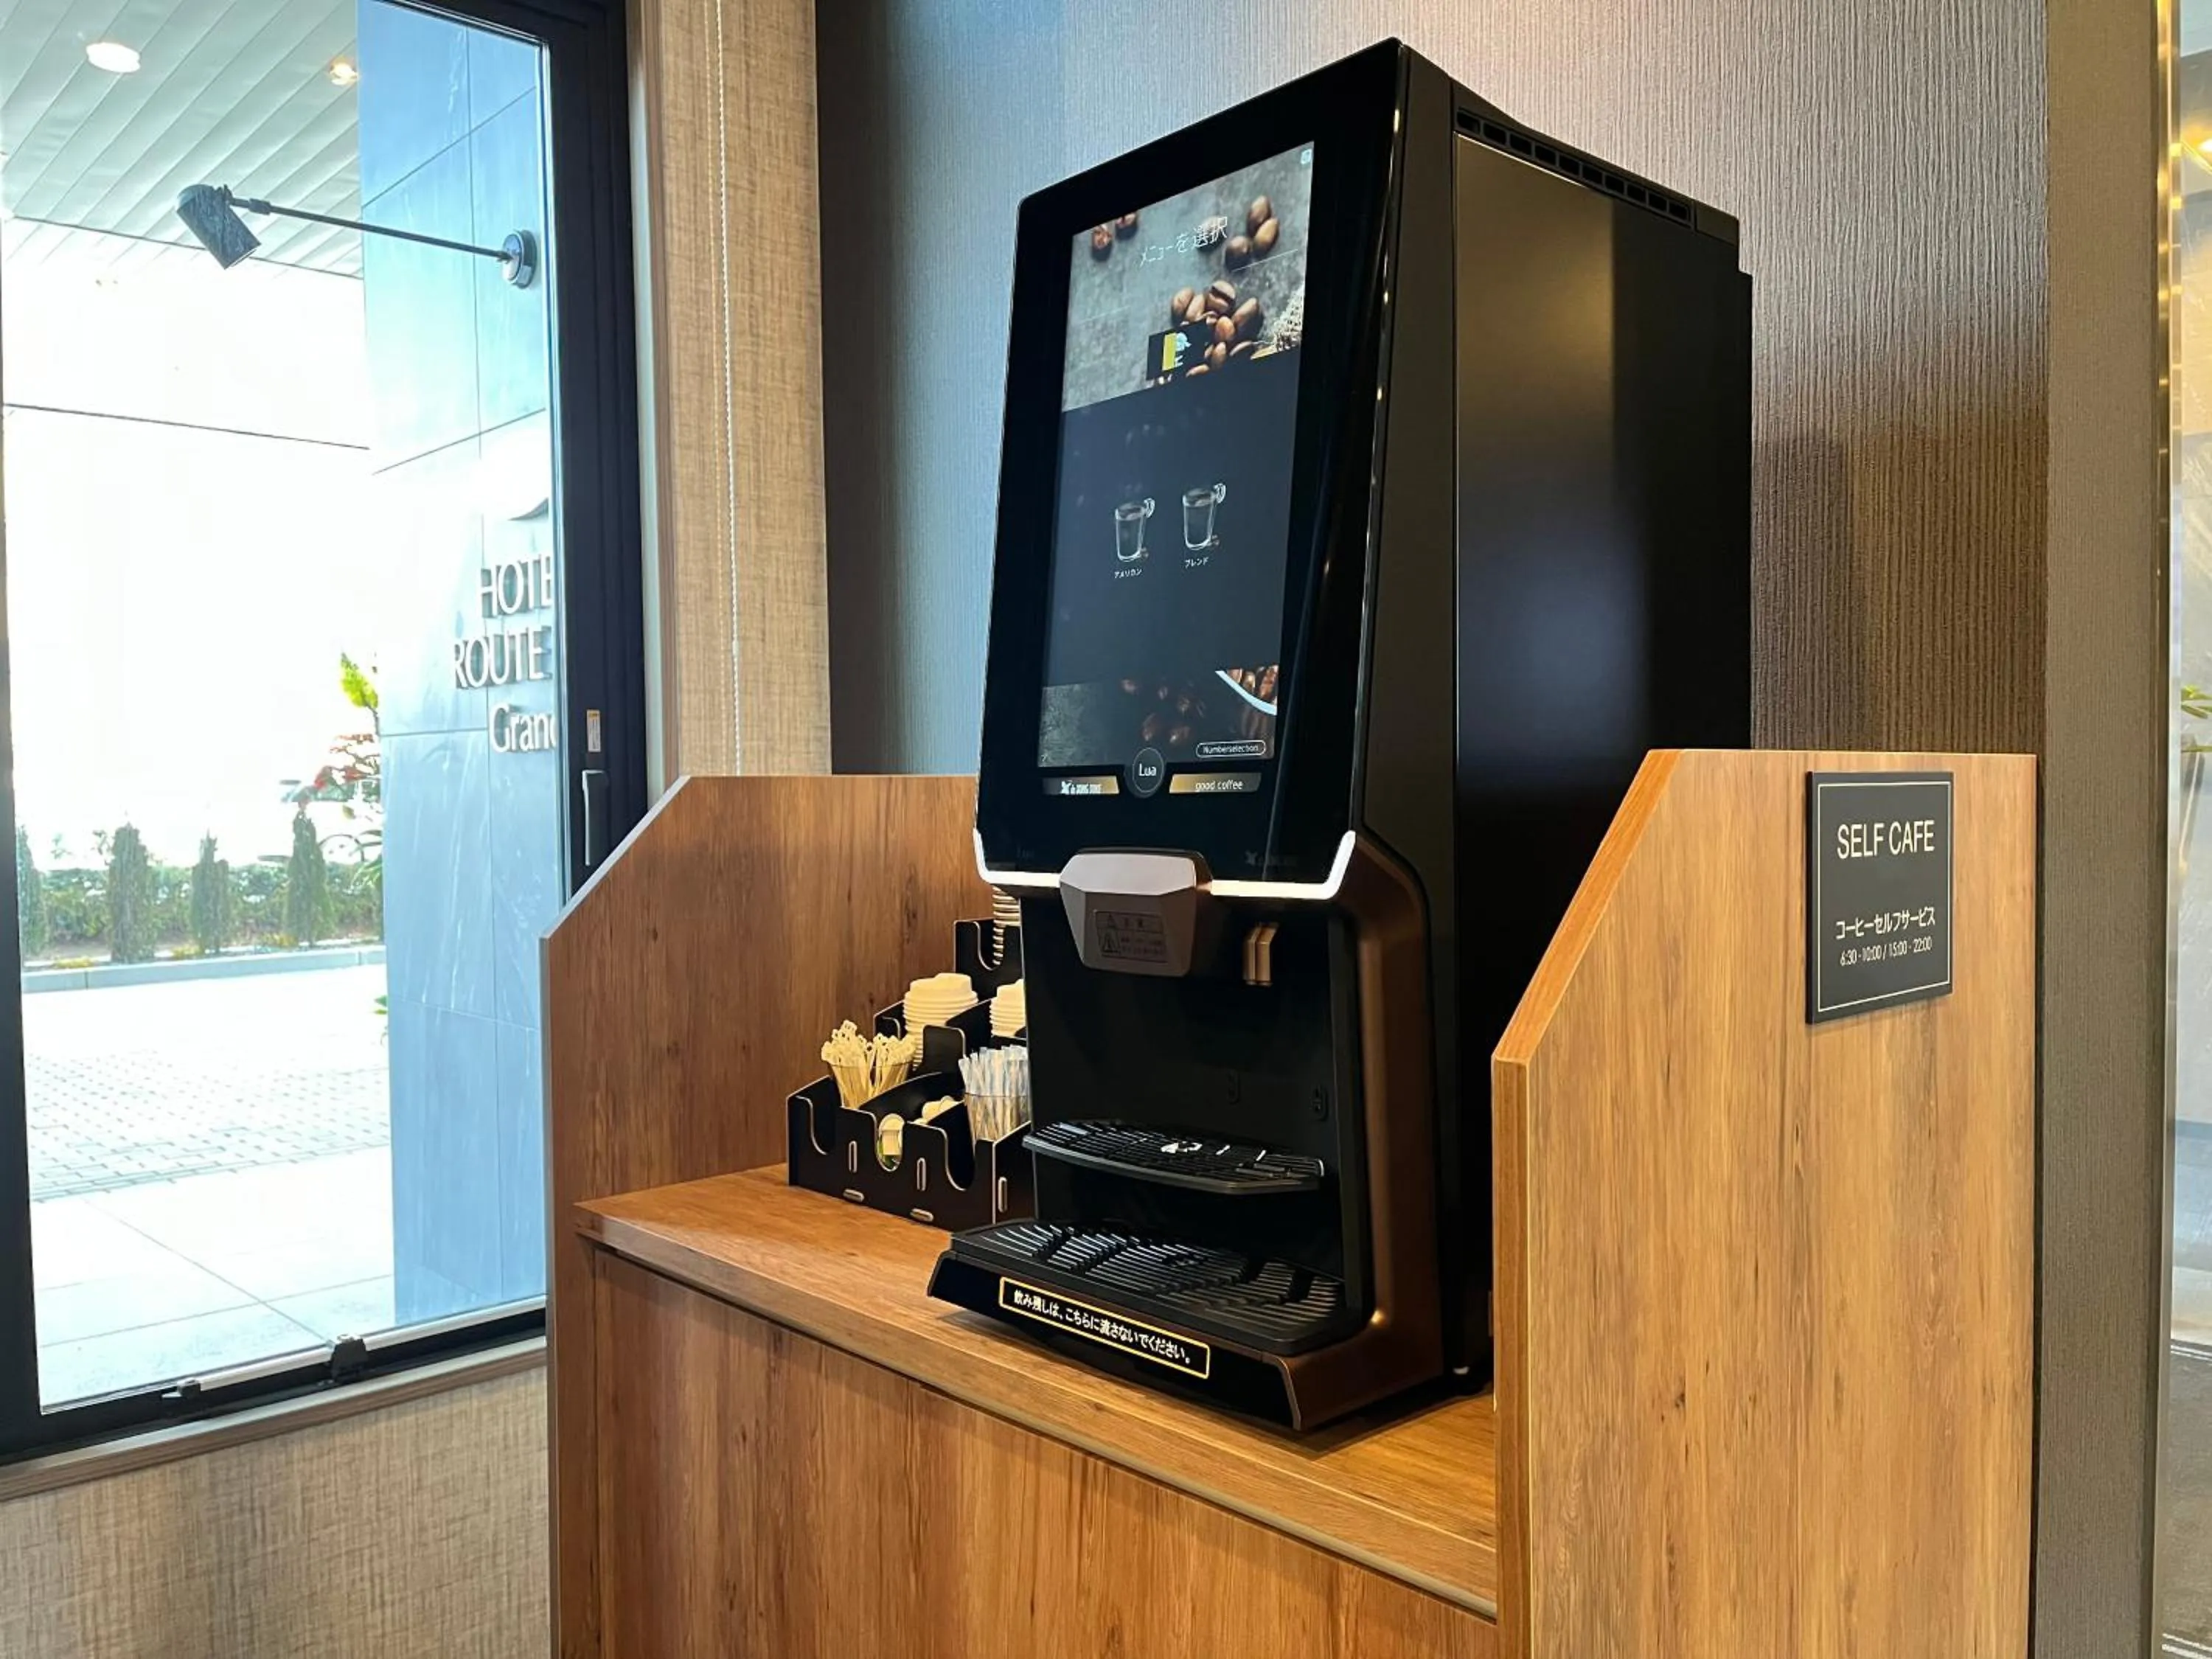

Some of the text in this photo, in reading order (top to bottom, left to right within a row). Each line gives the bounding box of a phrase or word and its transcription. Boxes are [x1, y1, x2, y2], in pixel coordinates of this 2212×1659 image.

[1138, 216, 1228, 267] メニューを選択
[451, 626, 546, 689] ROUTE
[1138, 763, 1157, 777] Lua
[1194, 779, 1243, 792] good coffee
[1837, 819, 1935, 859] SELF CAFE
[1836, 906, 1935, 940] コーヒーセルフサービス
